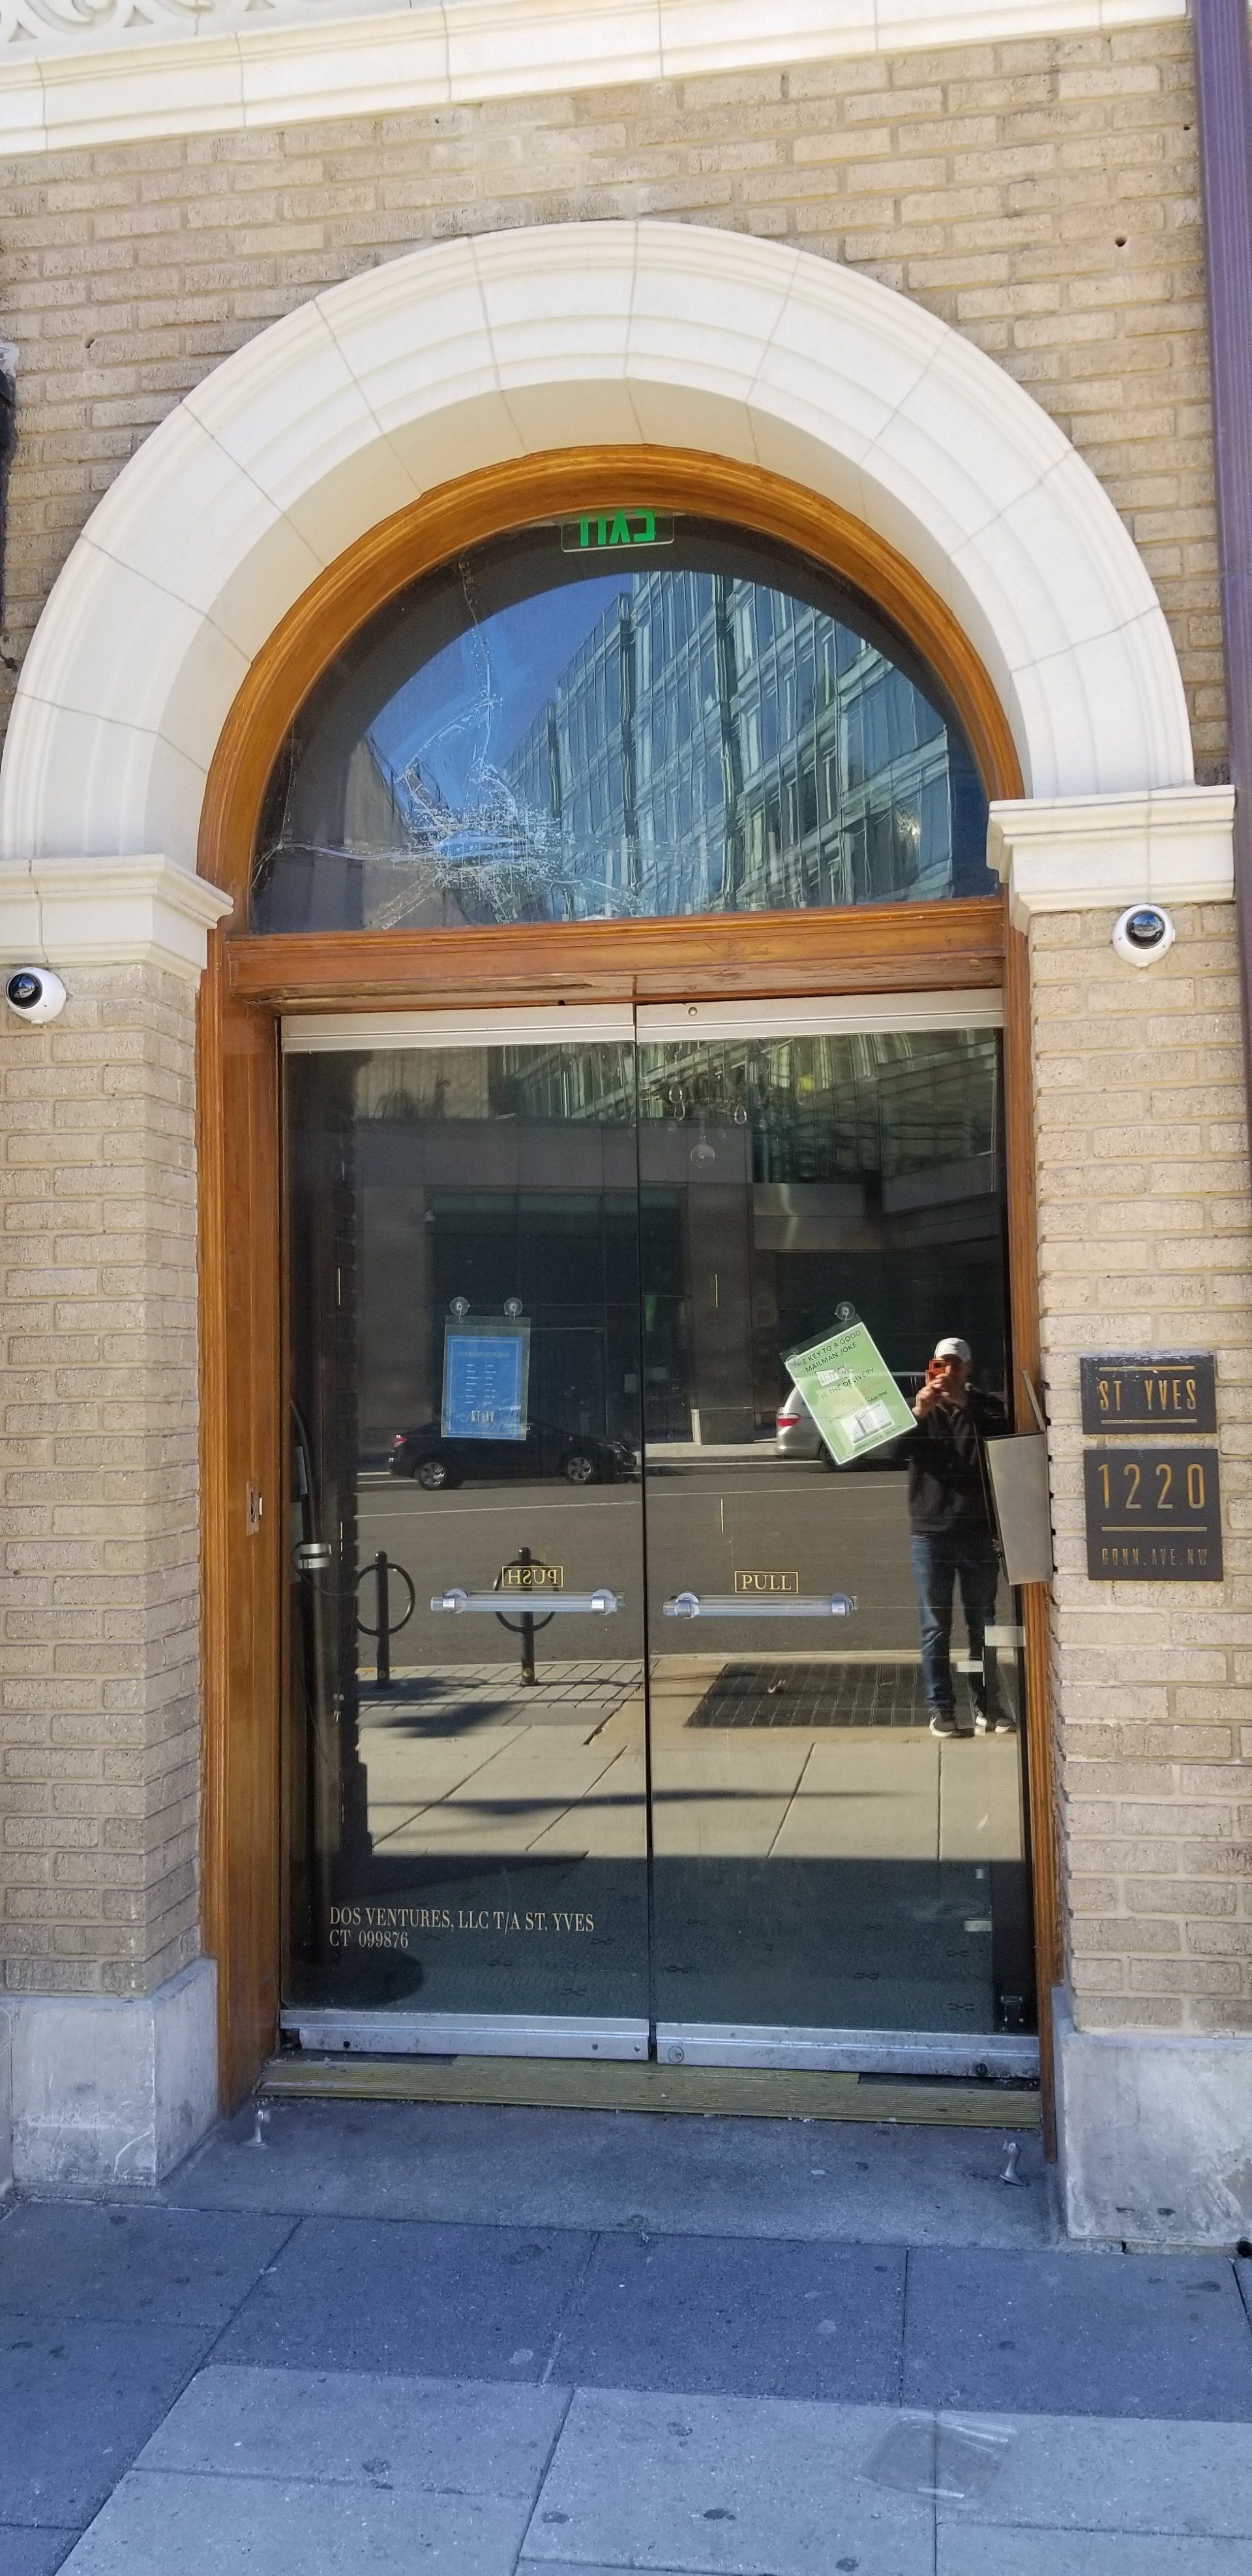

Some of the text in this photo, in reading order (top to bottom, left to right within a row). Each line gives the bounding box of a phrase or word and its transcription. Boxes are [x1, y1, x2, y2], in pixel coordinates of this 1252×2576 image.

[805, 1341, 857, 1373] MAILMAN JOKE
[808, 1351, 821, 1361] KEY
[840, 1330, 861, 1344] GOOD
[829, 1384, 842, 1394] THE
[1099, 1379, 1196, 1411] ST YVES
[1098, 1463, 1205, 1509] 1220
[741, 1574, 792, 1590] PULL
[330, 1906, 594, 1935] DOS VENTURES, LLC T/A ST. YVES
[329, 1929, 409, 1949] CT 099876
